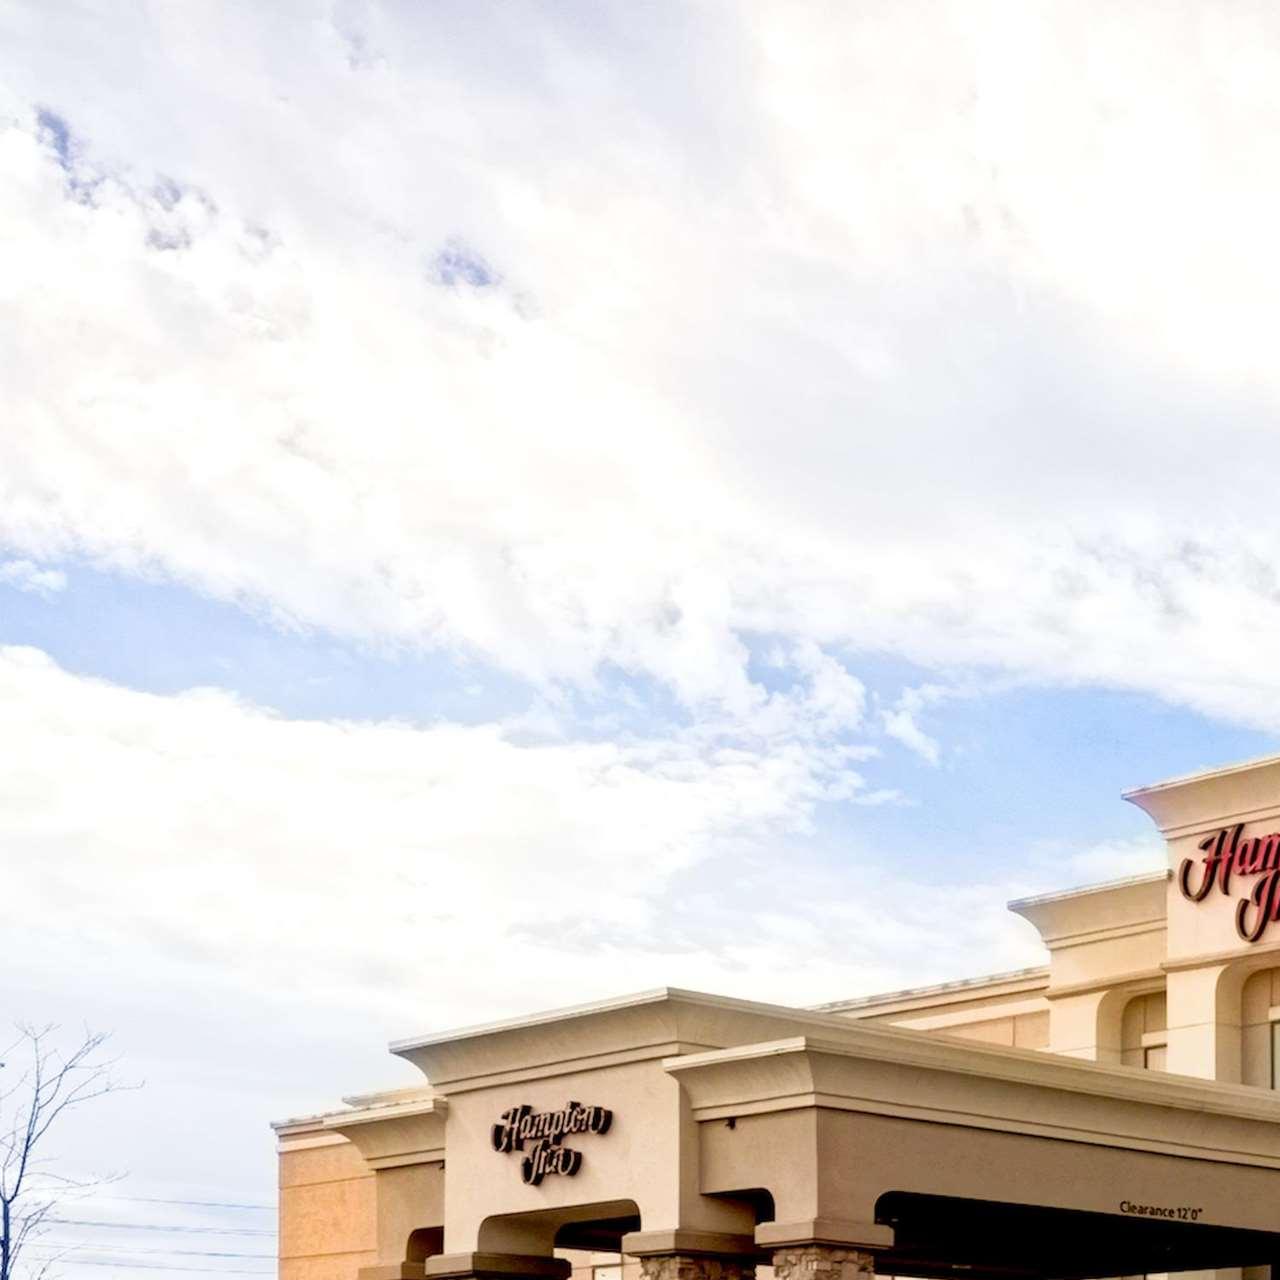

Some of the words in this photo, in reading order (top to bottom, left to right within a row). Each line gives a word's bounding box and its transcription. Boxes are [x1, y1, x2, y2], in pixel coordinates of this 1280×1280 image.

[491, 1101, 613, 1153] Hampton
[521, 1139, 583, 1186] Inn
[1120, 1200, 1175, 1218] Clearance
